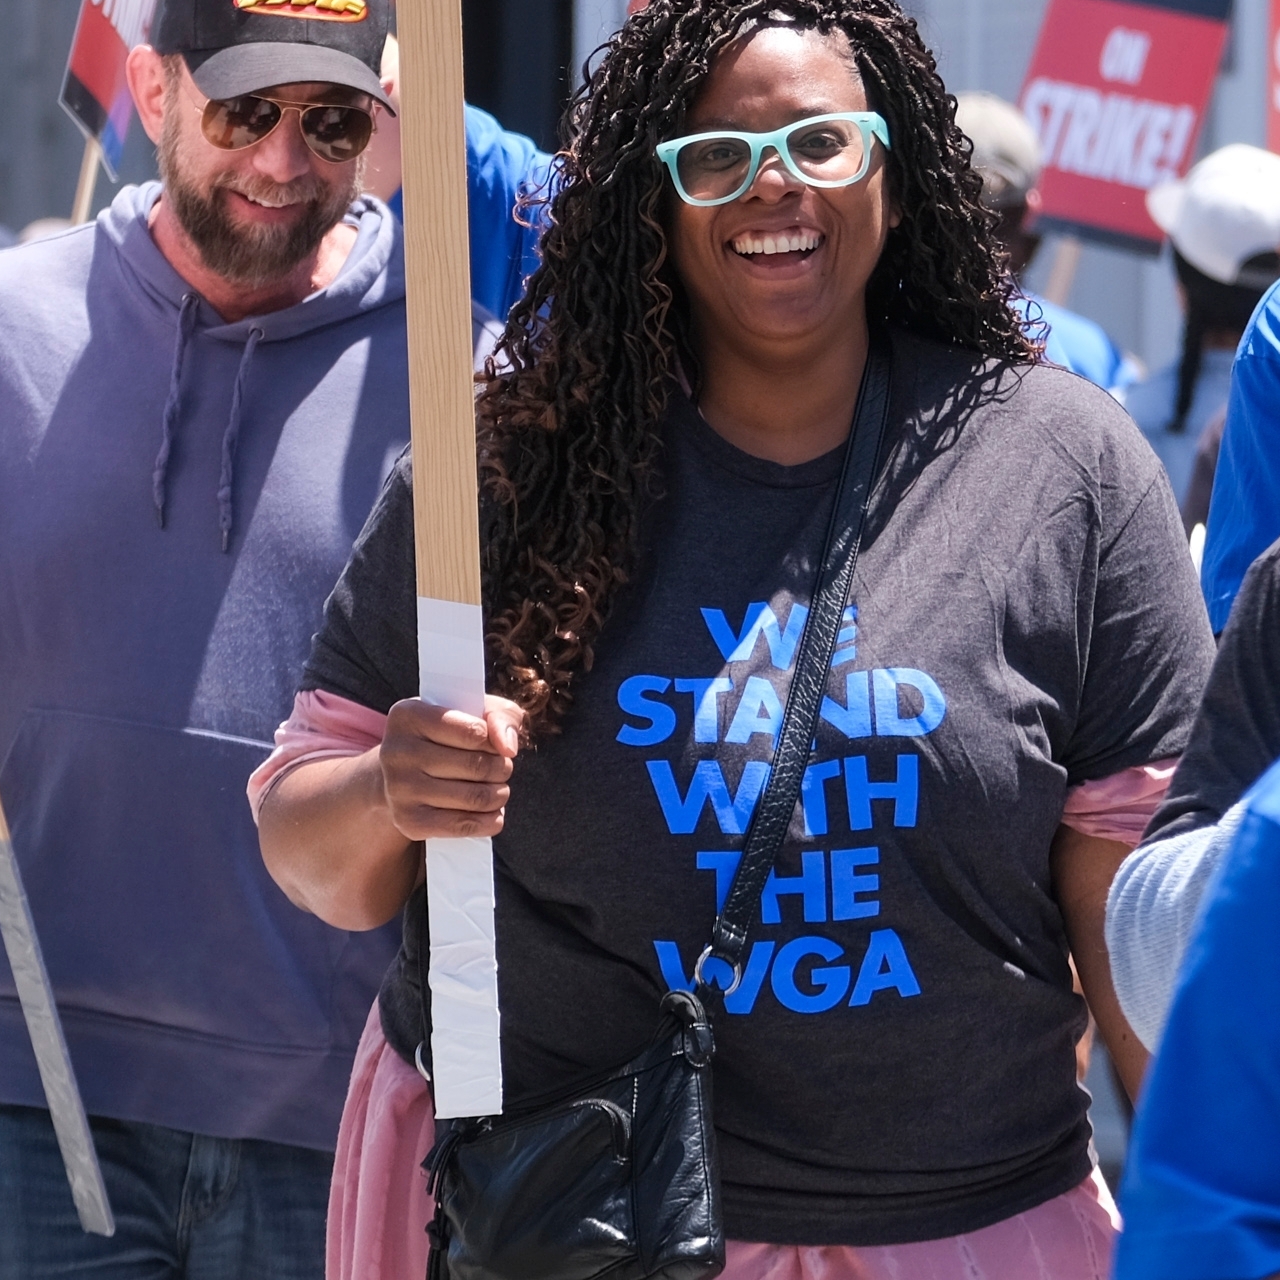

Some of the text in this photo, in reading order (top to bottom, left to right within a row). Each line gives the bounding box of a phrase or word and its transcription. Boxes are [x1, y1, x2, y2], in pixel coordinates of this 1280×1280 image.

[1099, 24, 1153, 86] ON
[700, 601, 858, 671] WE
[615, 667, 947, 750] STAND
[646, 753, 919, 837] WTH
[696, 846, 880, 925] THE
[653, 928, 922, 1017] WGA
